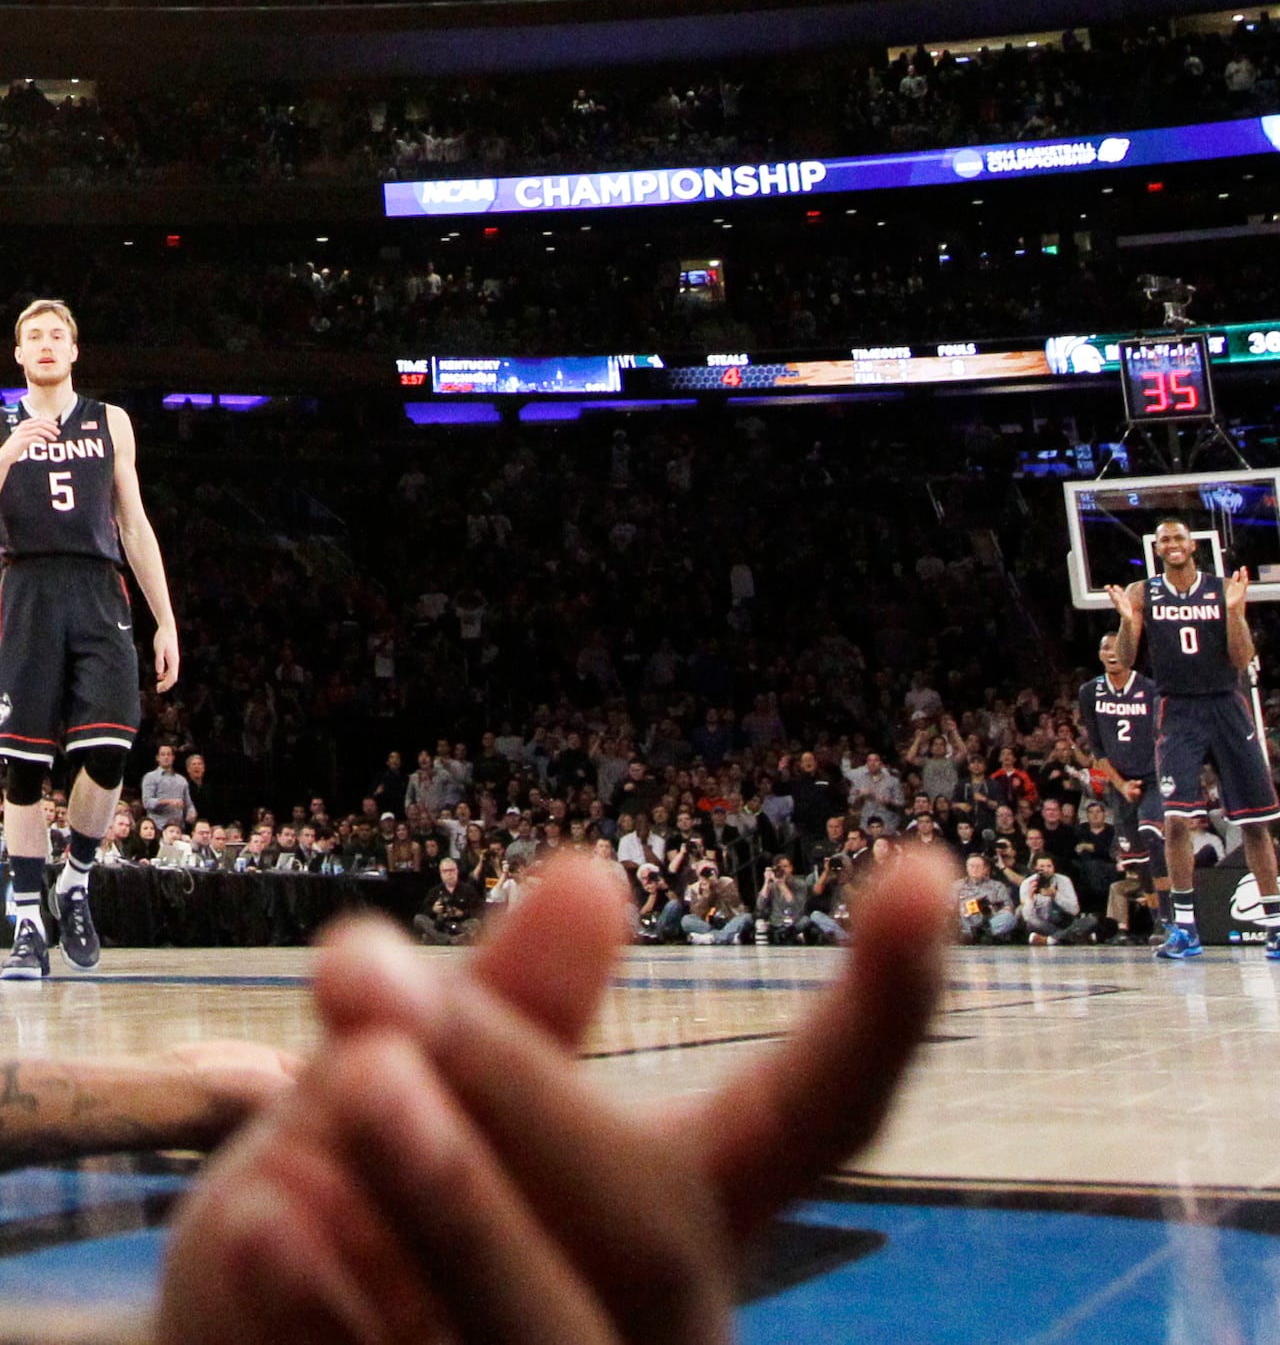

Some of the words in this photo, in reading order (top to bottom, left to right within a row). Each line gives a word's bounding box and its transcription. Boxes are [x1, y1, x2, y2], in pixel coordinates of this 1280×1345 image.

[1017, 142, 1094, 161] BASKETBALL
[987, 152, 1096, 173] CHAMPIONSHIP
[422, 180, 495, 204] NCAA
[515, 161, 826, 209] CHAMPIONSHIP
[851, 347, 911, 360] TIMEOUTS
[937, 343, 976, 357] FOULS
[396, 360, 428, 373] TIME
[707, 354, 749, 367] STEALS
[722, 367, 742, 386] 4
[1142, 370, 1199, 412] 35
[49, 471, 75, 511] 5
[1152, 605, 1220, 621] UCONN
[1179, 626, 1199, 655] 0
[1095, 700, 1147, 716] UCONN
[1117, 720, 1131, 742] 2
